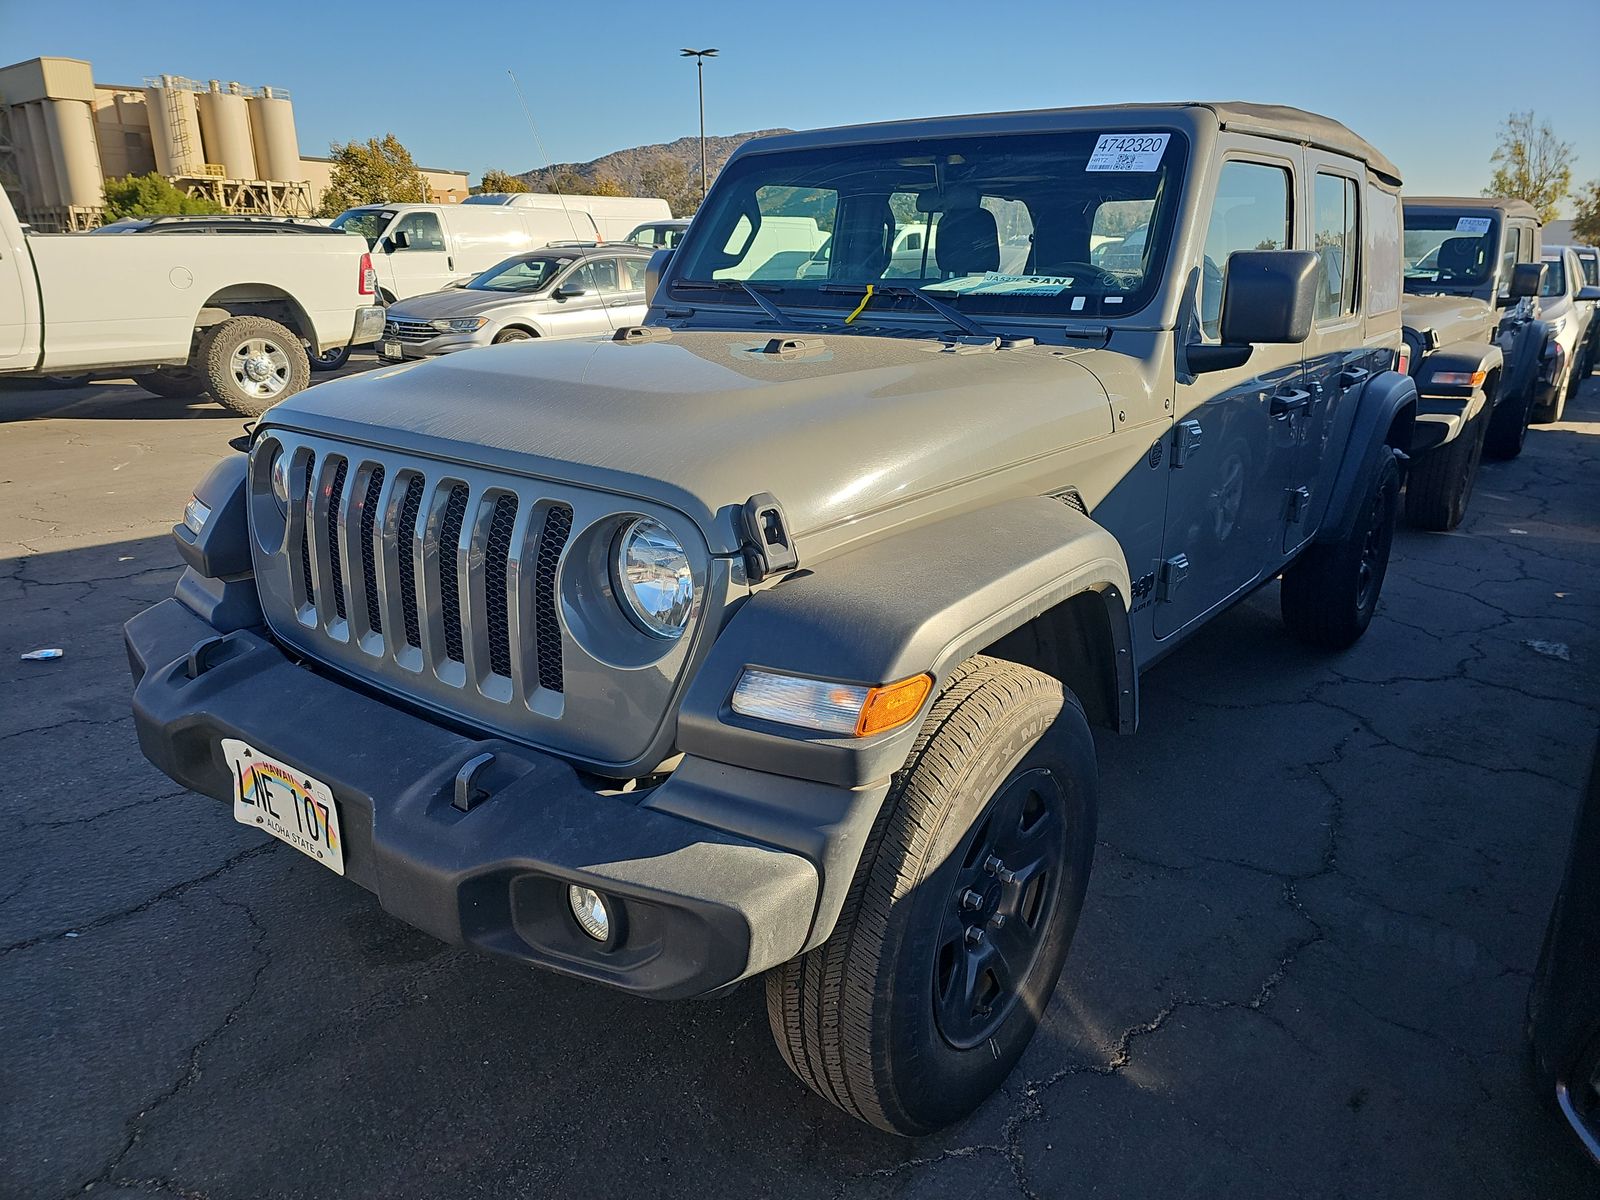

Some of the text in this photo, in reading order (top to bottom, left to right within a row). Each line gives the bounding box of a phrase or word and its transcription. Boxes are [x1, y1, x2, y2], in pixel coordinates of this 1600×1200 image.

[1098, 138, 1163, 152] 4742320
[1027, 277, 1067, 285] SAN
[262, 761, 295, 785] HAWAII
[972, 740, 1015, 802] LTX
[235, 759, 330, 849] LNE 107
[266, 818, 316, 855] ALOHA STATE
